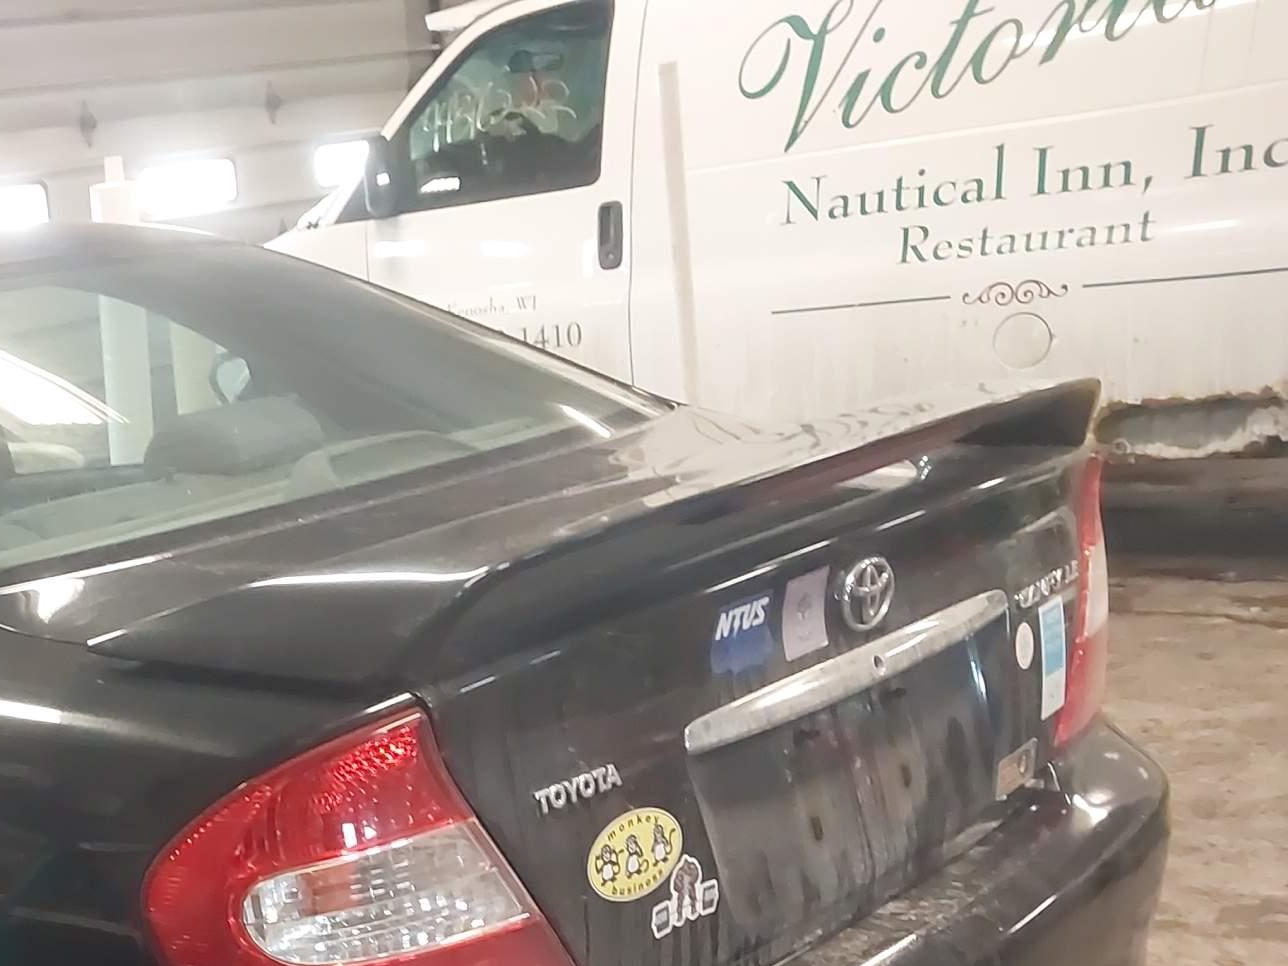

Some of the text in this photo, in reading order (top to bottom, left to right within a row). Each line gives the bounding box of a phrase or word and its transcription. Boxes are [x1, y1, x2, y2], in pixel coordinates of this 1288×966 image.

[780, 142, 1007, 226] Nautical
[1031, 144, 1154, 196] Inn,
[896, 210, 1158, 265] Restaurant
[715, 596, 771, 641] NTUS
[533, 763, 623, 815] TOYOTA
[607, 814, 660, 843] monkey
[611, 869, 664, 897] business
